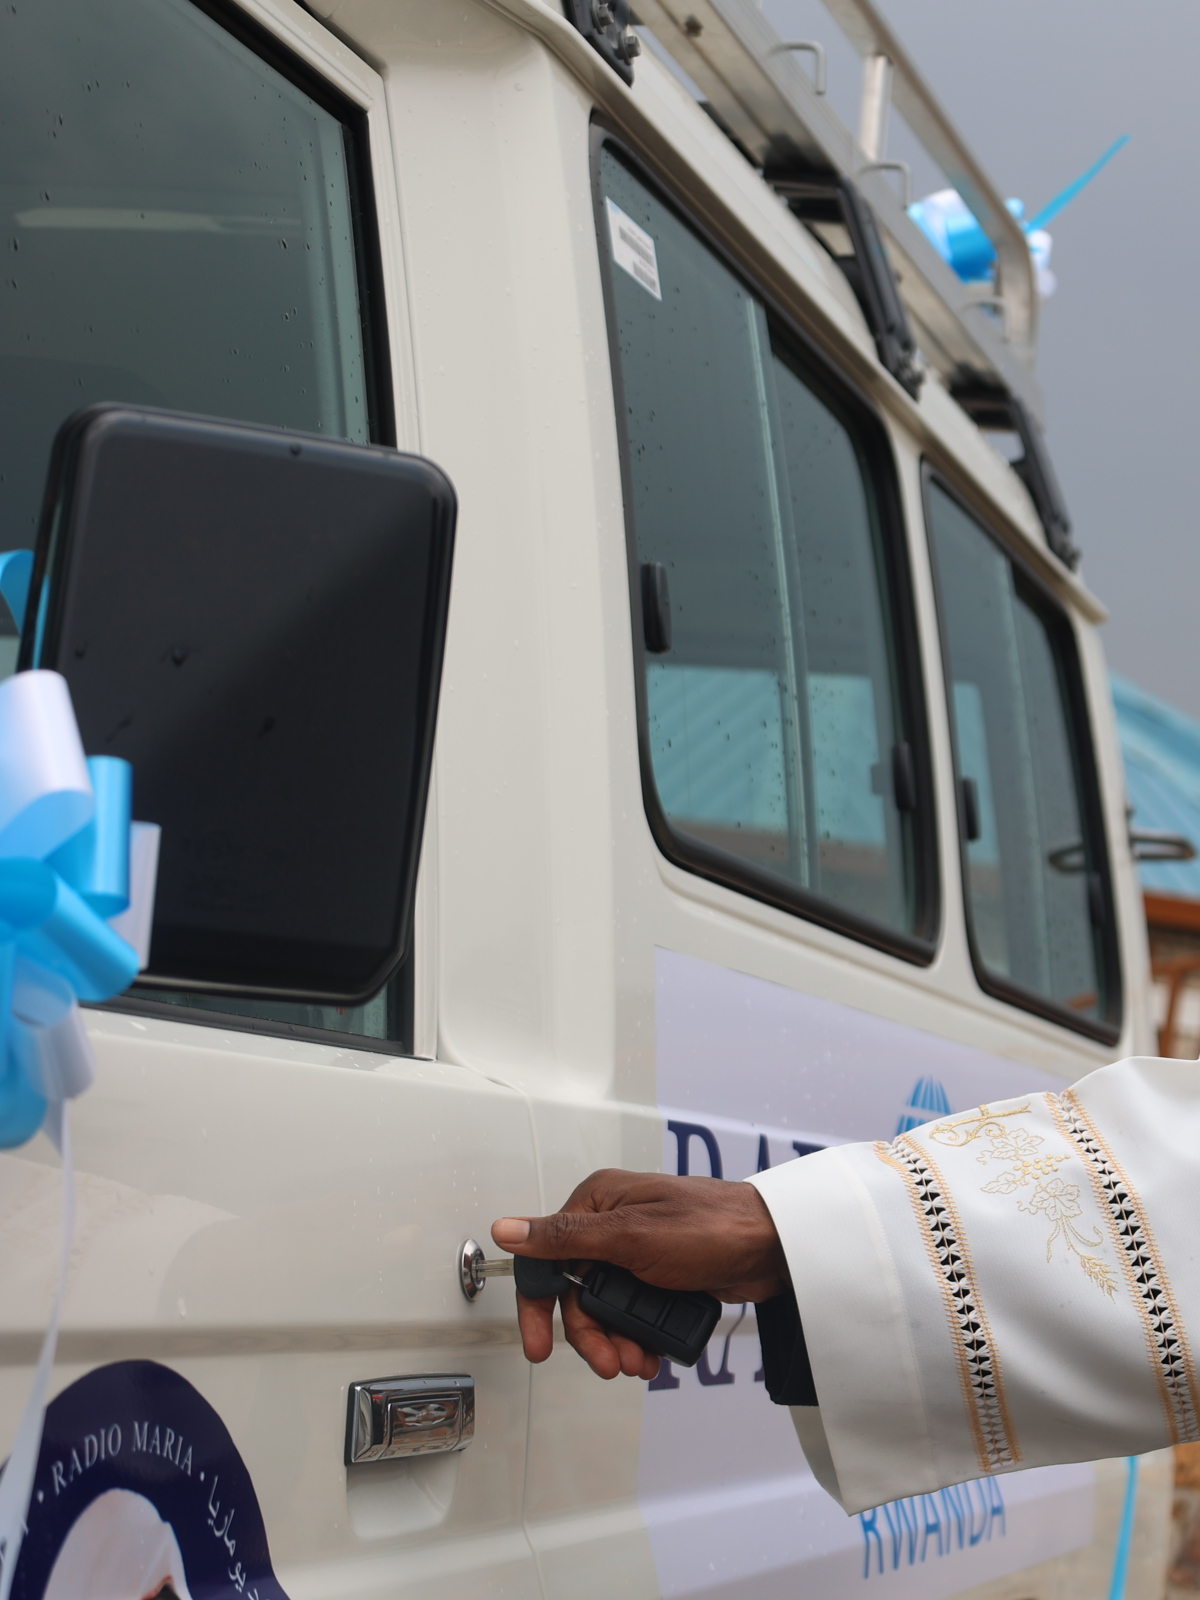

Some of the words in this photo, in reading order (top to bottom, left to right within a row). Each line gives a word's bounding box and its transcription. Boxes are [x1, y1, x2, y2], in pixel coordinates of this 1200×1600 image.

[51, 1423, 122, 1496] RADIO
[132, 1420, 193, 1477] MARIA
[859, 1475, 1006, 1579] RWANDA
